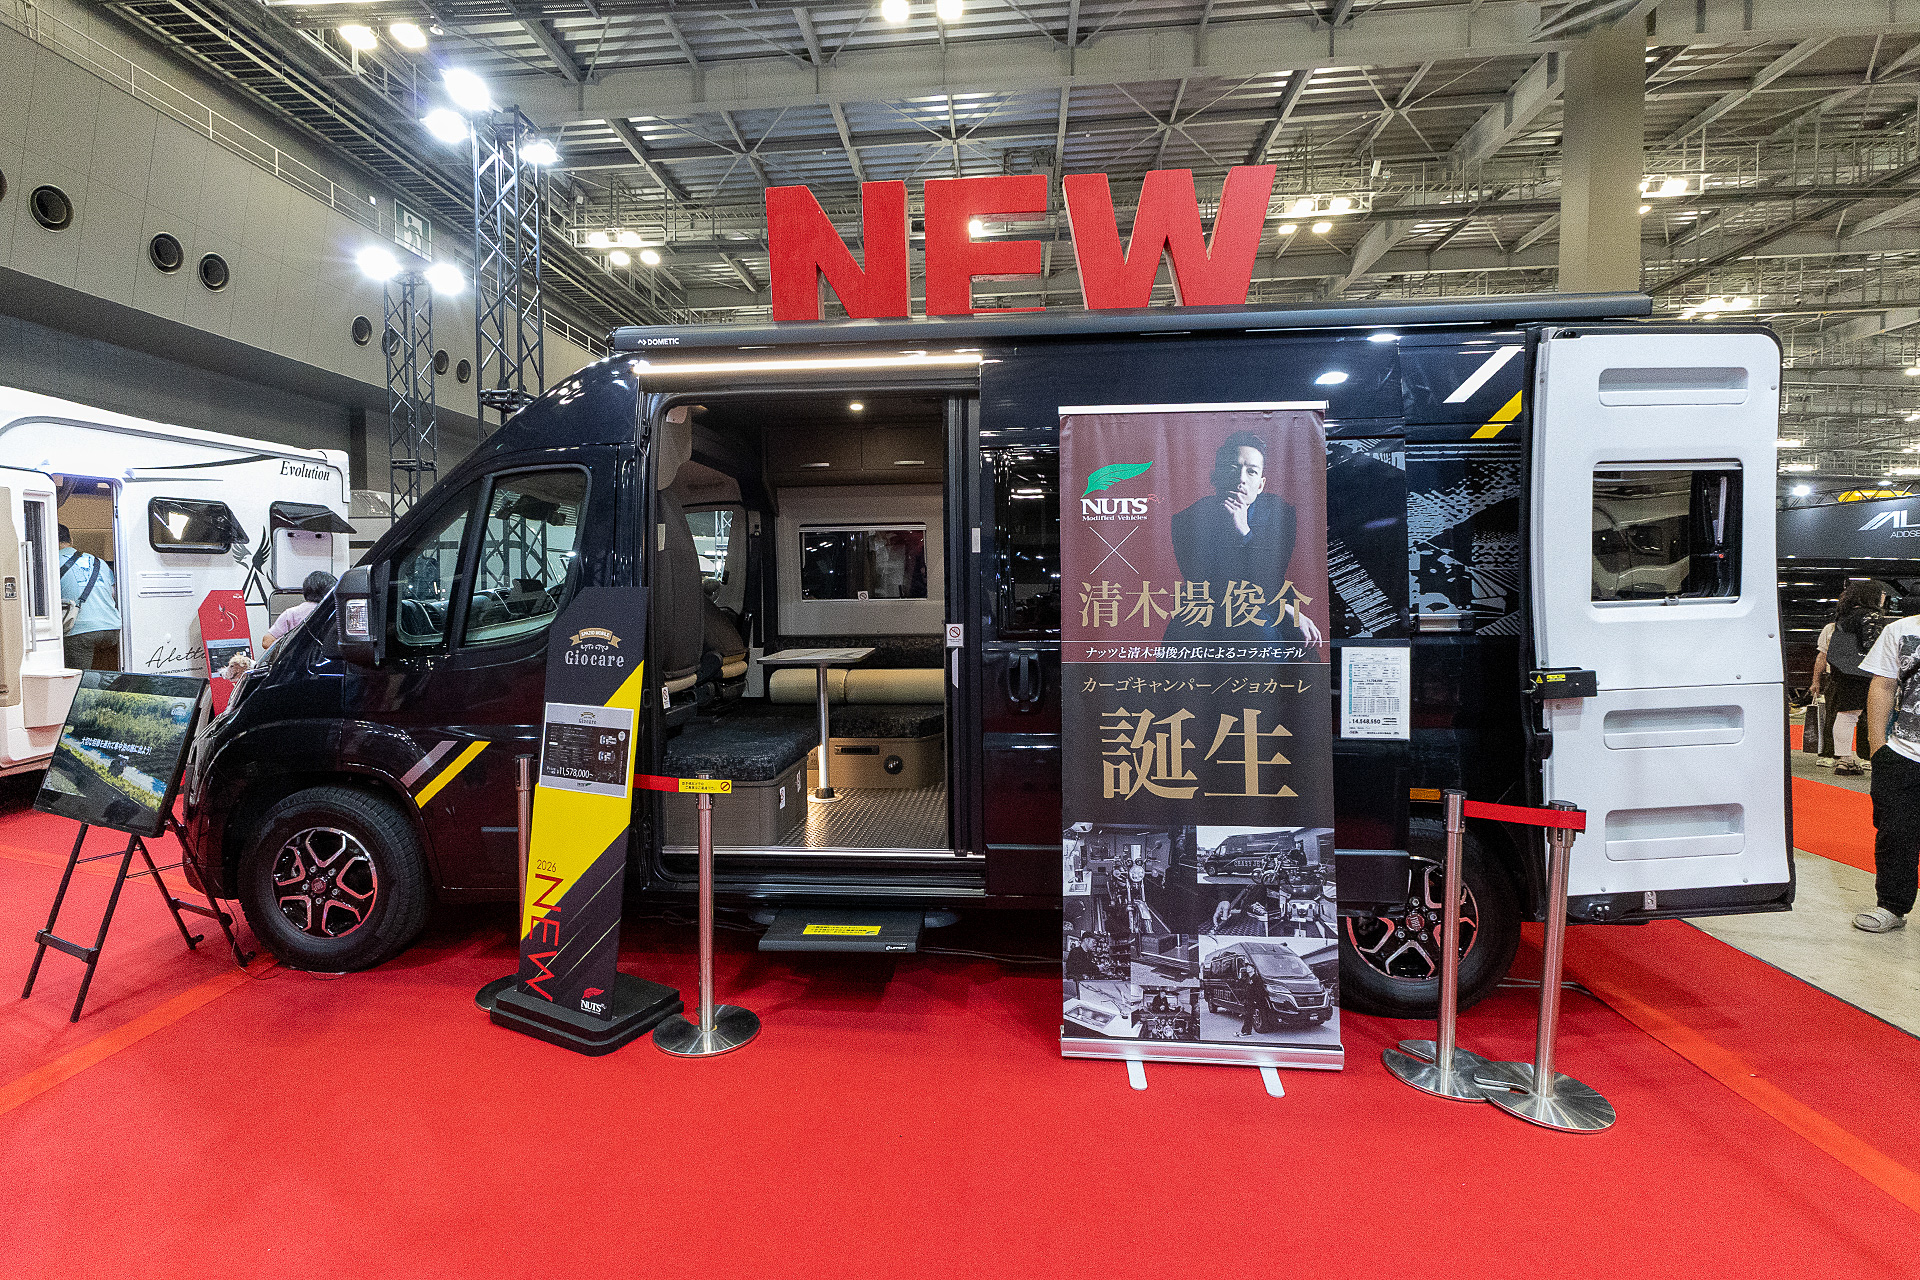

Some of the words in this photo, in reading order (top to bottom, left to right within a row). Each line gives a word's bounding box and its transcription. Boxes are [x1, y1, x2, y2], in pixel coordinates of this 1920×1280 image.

[765, 163, 1277, 322] NEW
[647, 337, 680, 346] DOMETIC
[280, 459, 331, 482] Evolution
[1080, 497, 1148, 515] NUTS
[1078, 579, 1314, 629] 清木場俊介
[565, 649, 625, 667] Giocare
[1084, 646, 1307, 660] ナッツと清木場俊介氏によるコラボモデル
[1099, 706, 1300, 801] 誕生
[536, 859, 557, 873] 2026
[524, 873, 564, 1002] NEW
[581, 999, 601, 1012] NUTS
